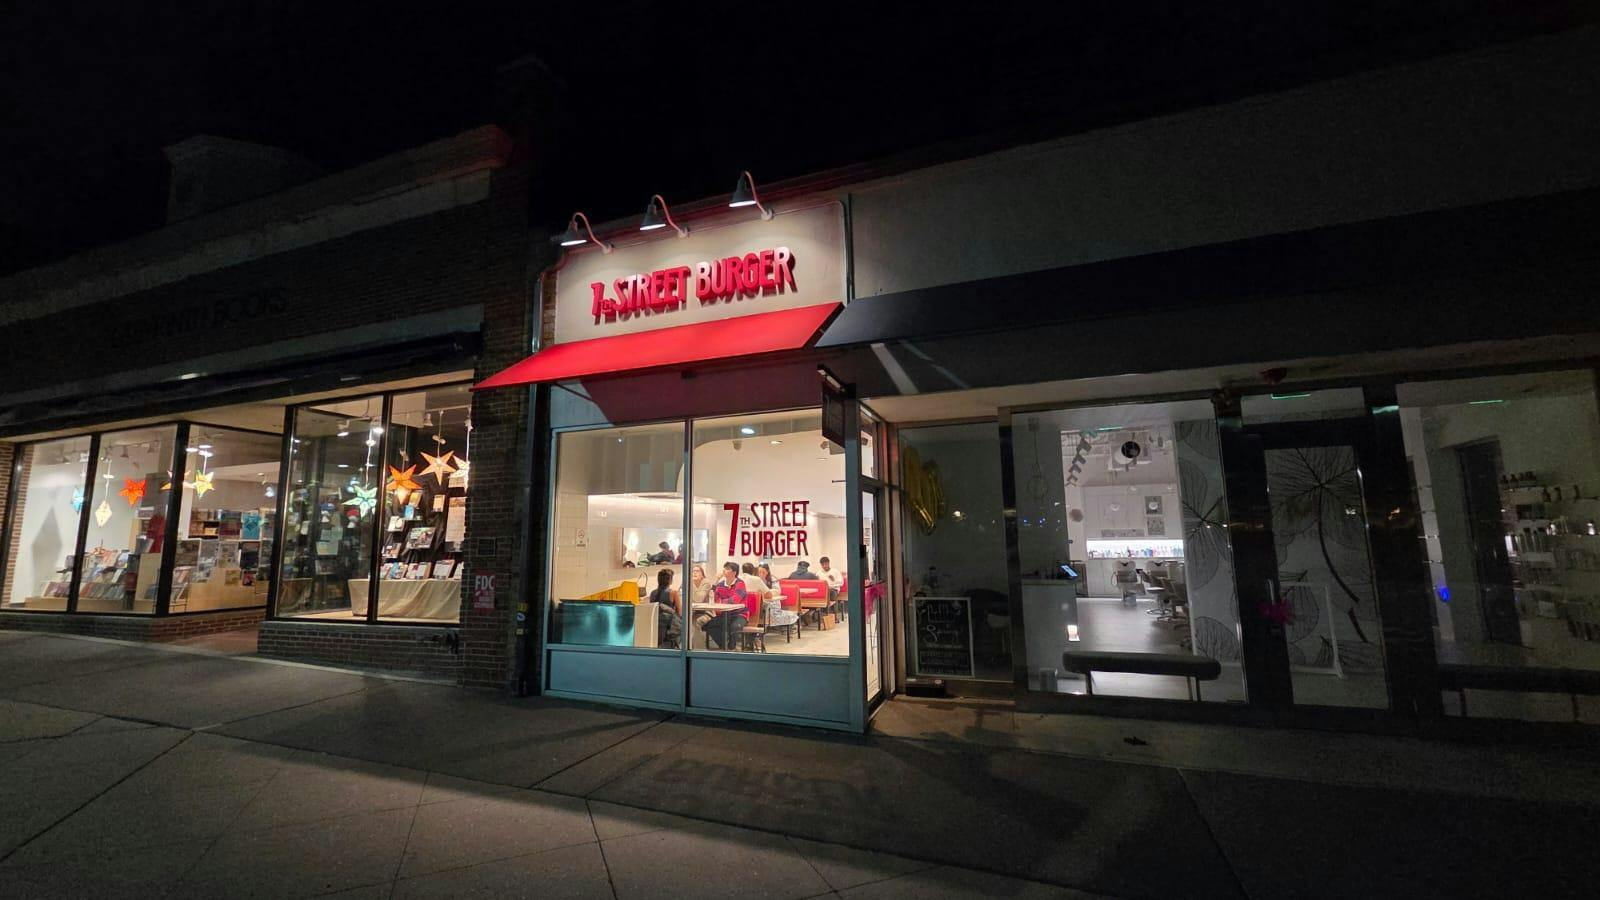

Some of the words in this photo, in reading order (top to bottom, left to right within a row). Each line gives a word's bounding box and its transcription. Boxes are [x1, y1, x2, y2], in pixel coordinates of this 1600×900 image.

[612, 266, 691, 312] STREET
[695, 247, 797, 301] BURGER
[750, 500, 810, 528] STREET
[741, 530, 809, 557] BURGER
[474, 575, 495, 592] FDC
